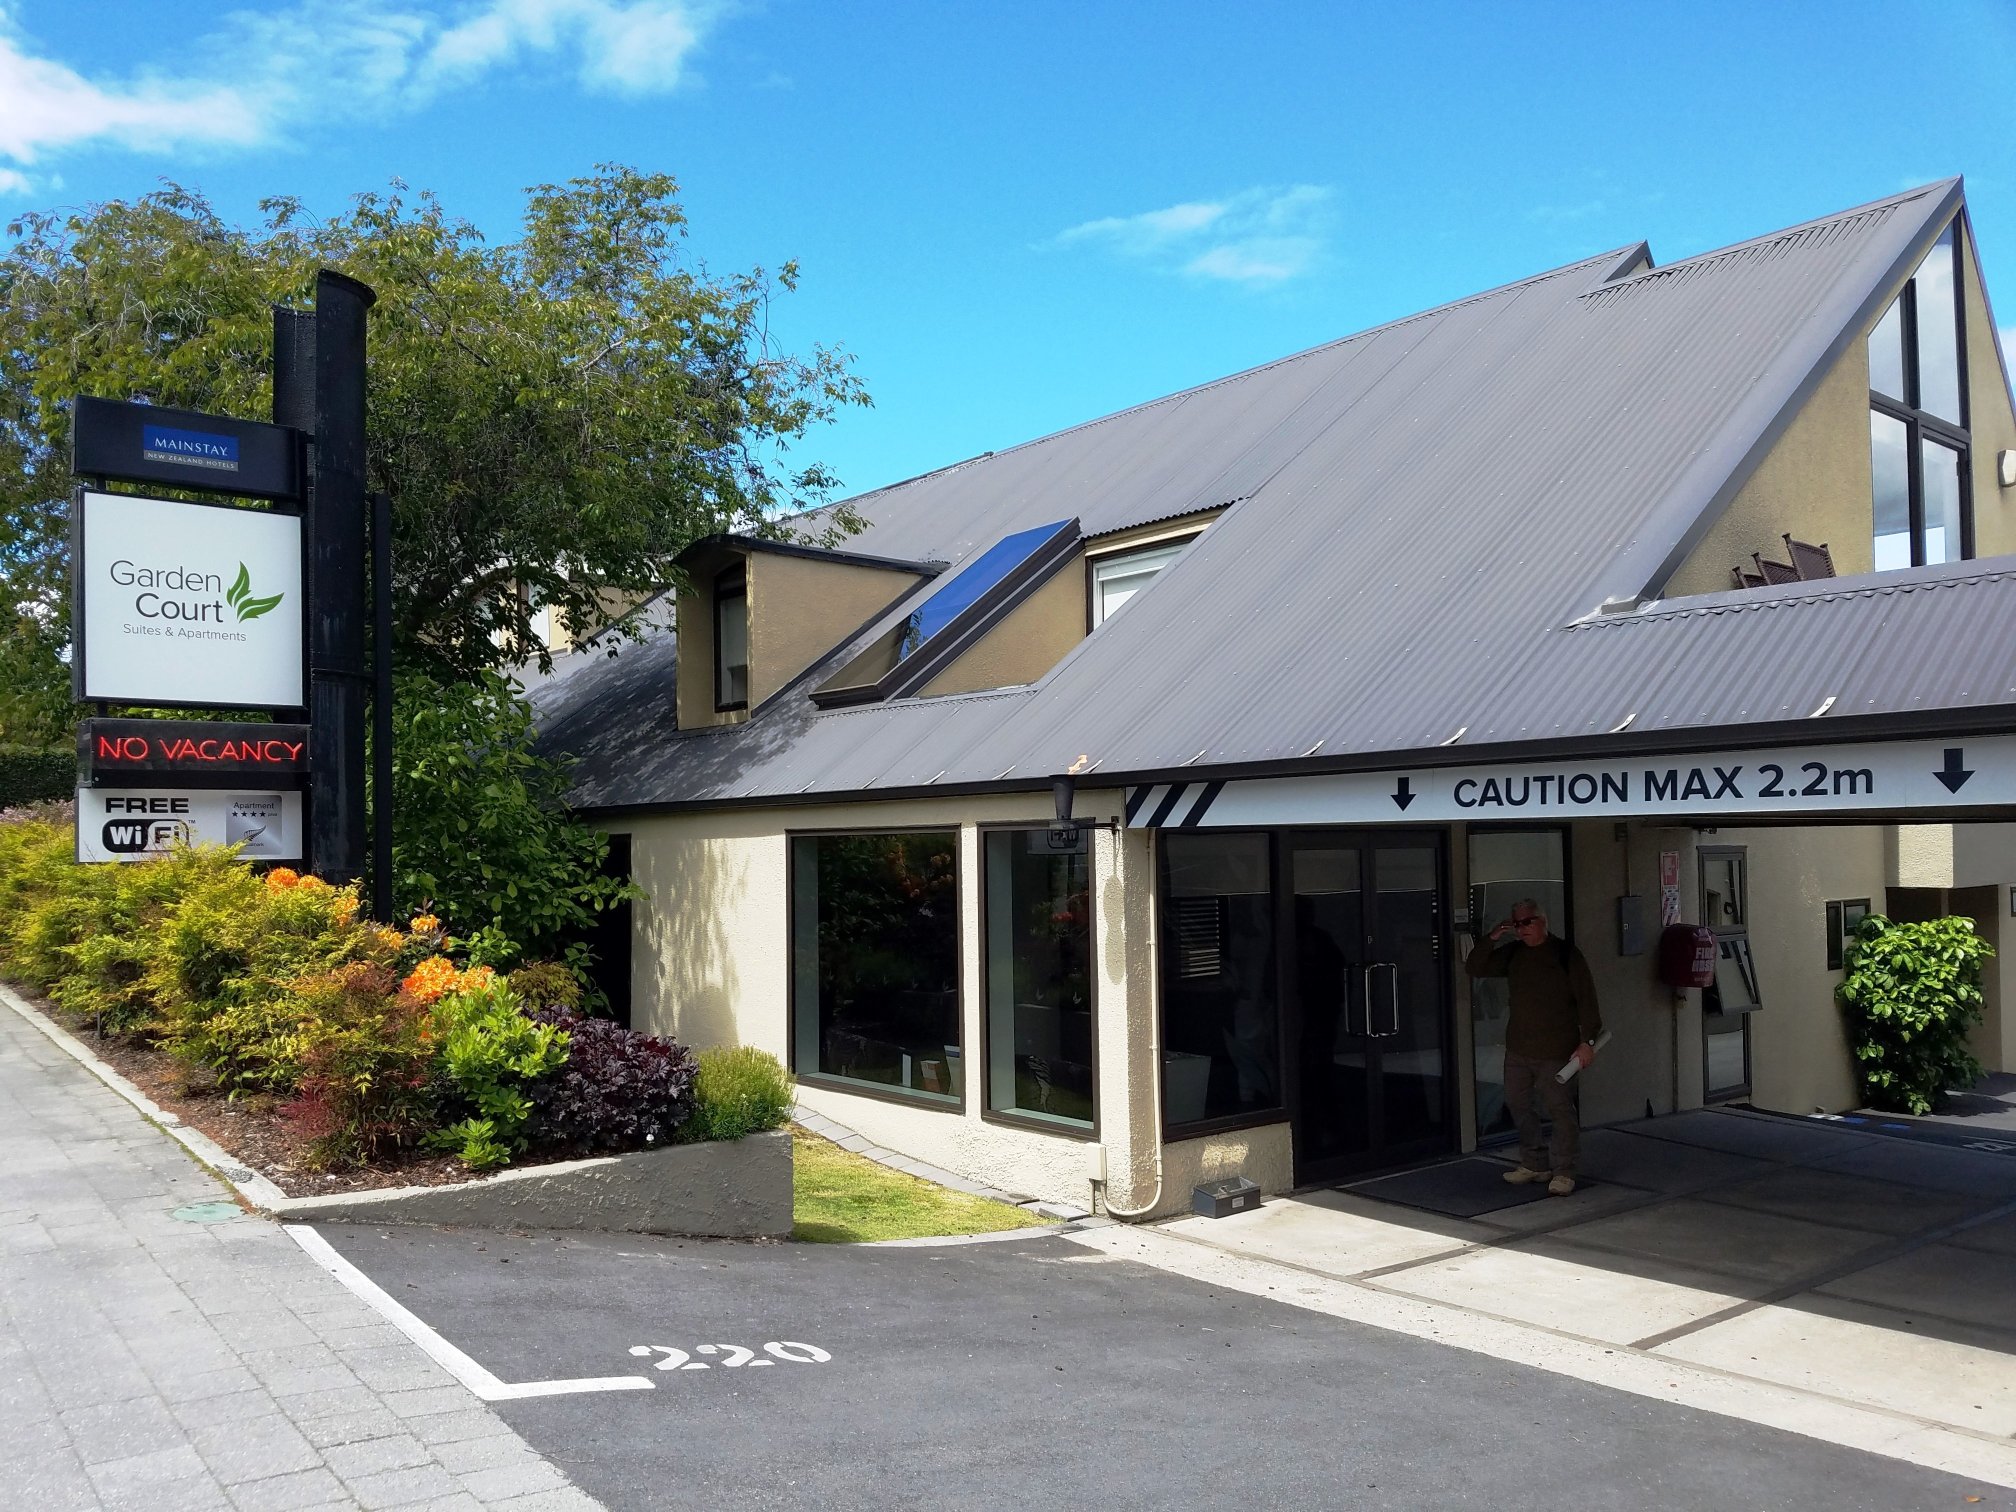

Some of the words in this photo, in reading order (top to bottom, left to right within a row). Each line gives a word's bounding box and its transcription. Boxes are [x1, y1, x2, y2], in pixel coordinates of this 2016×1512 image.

[154, 437, 228, 457] MAINSTAY
[147, 452, 166, 460] NEW
[168, 455, 203, 465] ZEALAND
[206, 460, 235, 469] HOTELS
[110, 559, 221, 593] Garden
[135, 592, 224, 623] Court
[123, 623, 161, 636] Suites
[164, 626, 174, 637] &
[178, 627, 247, 642] Apartments
[100, 736, 148, 760] NO
[158, 737, 304, 761] VACANCY
[1453, 770, 1629, 808] CAUTION
[1645, 765, 1745, 802] MAX
[1758, 761, 1874, 799] 2.2m
[105, 797, 190, 814] FREE
[233, 801, 275, 811] Apartment
[628, 1341, 832, 1371] 220
